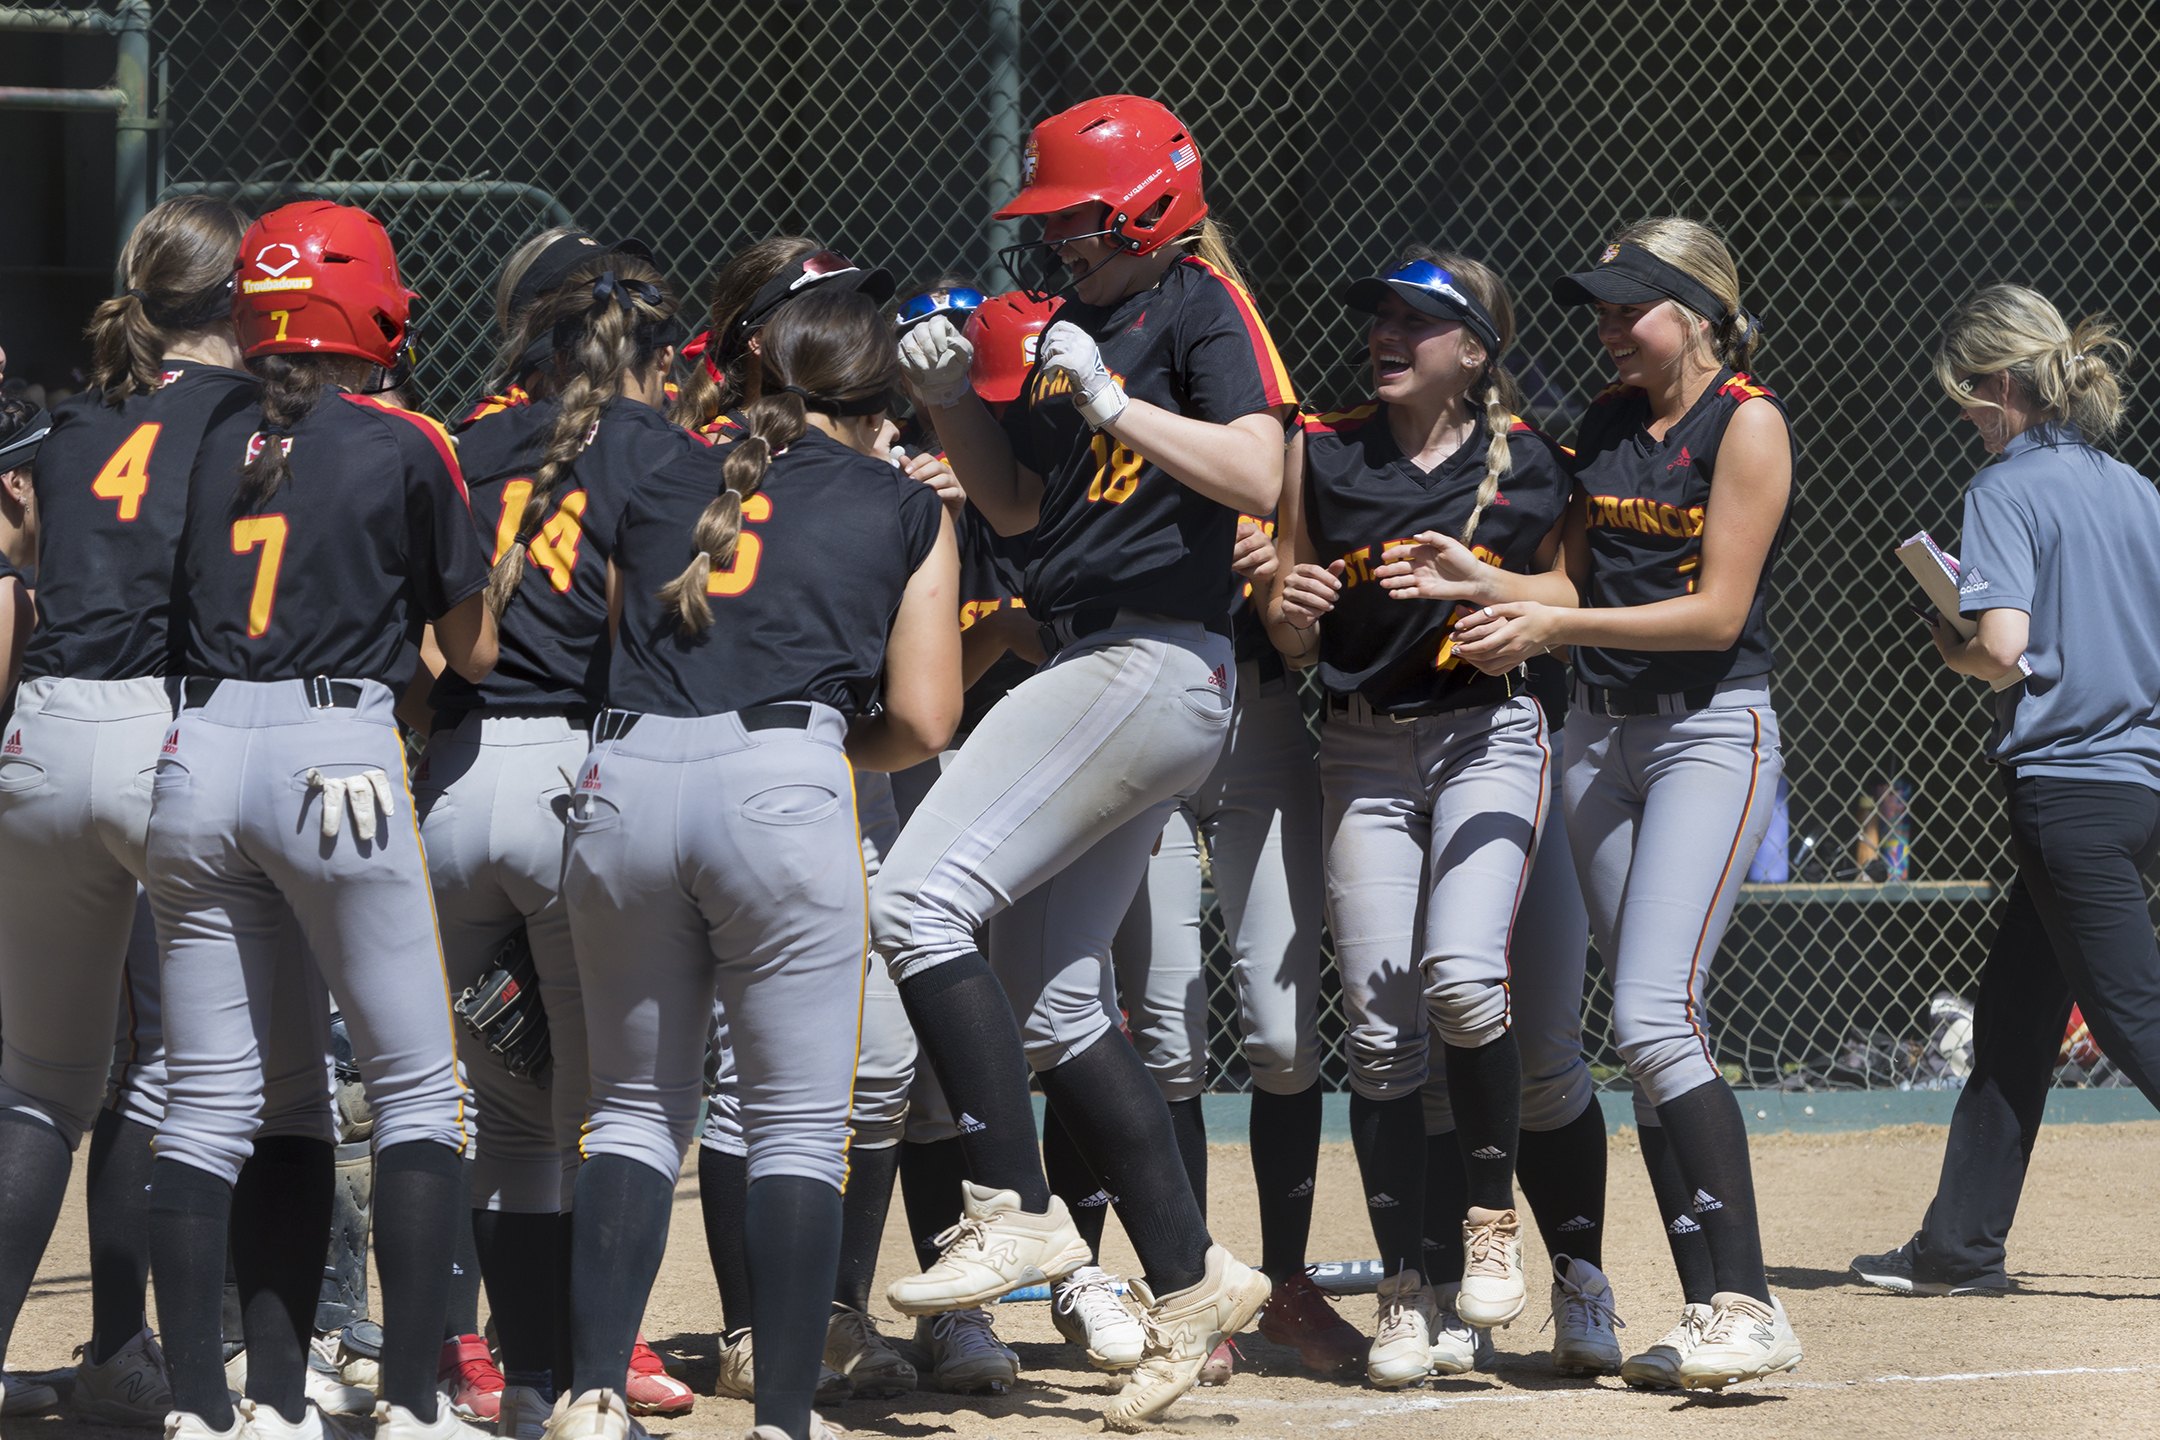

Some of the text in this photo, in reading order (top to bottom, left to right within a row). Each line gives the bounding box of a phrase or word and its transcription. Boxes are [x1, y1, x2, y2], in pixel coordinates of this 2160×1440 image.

[243, 276, 313, 294] Troubadours
[270, 310, 290, 342] 7
[91, 421, 163, 522] 4
[1086, 432, 1145, 506] 18
[231, 512, 289, 640] 7
[491, 477, 588, 595] 14
[705, 490, 774, 598] 6
[1959, 581, 1990, 595] adidas
